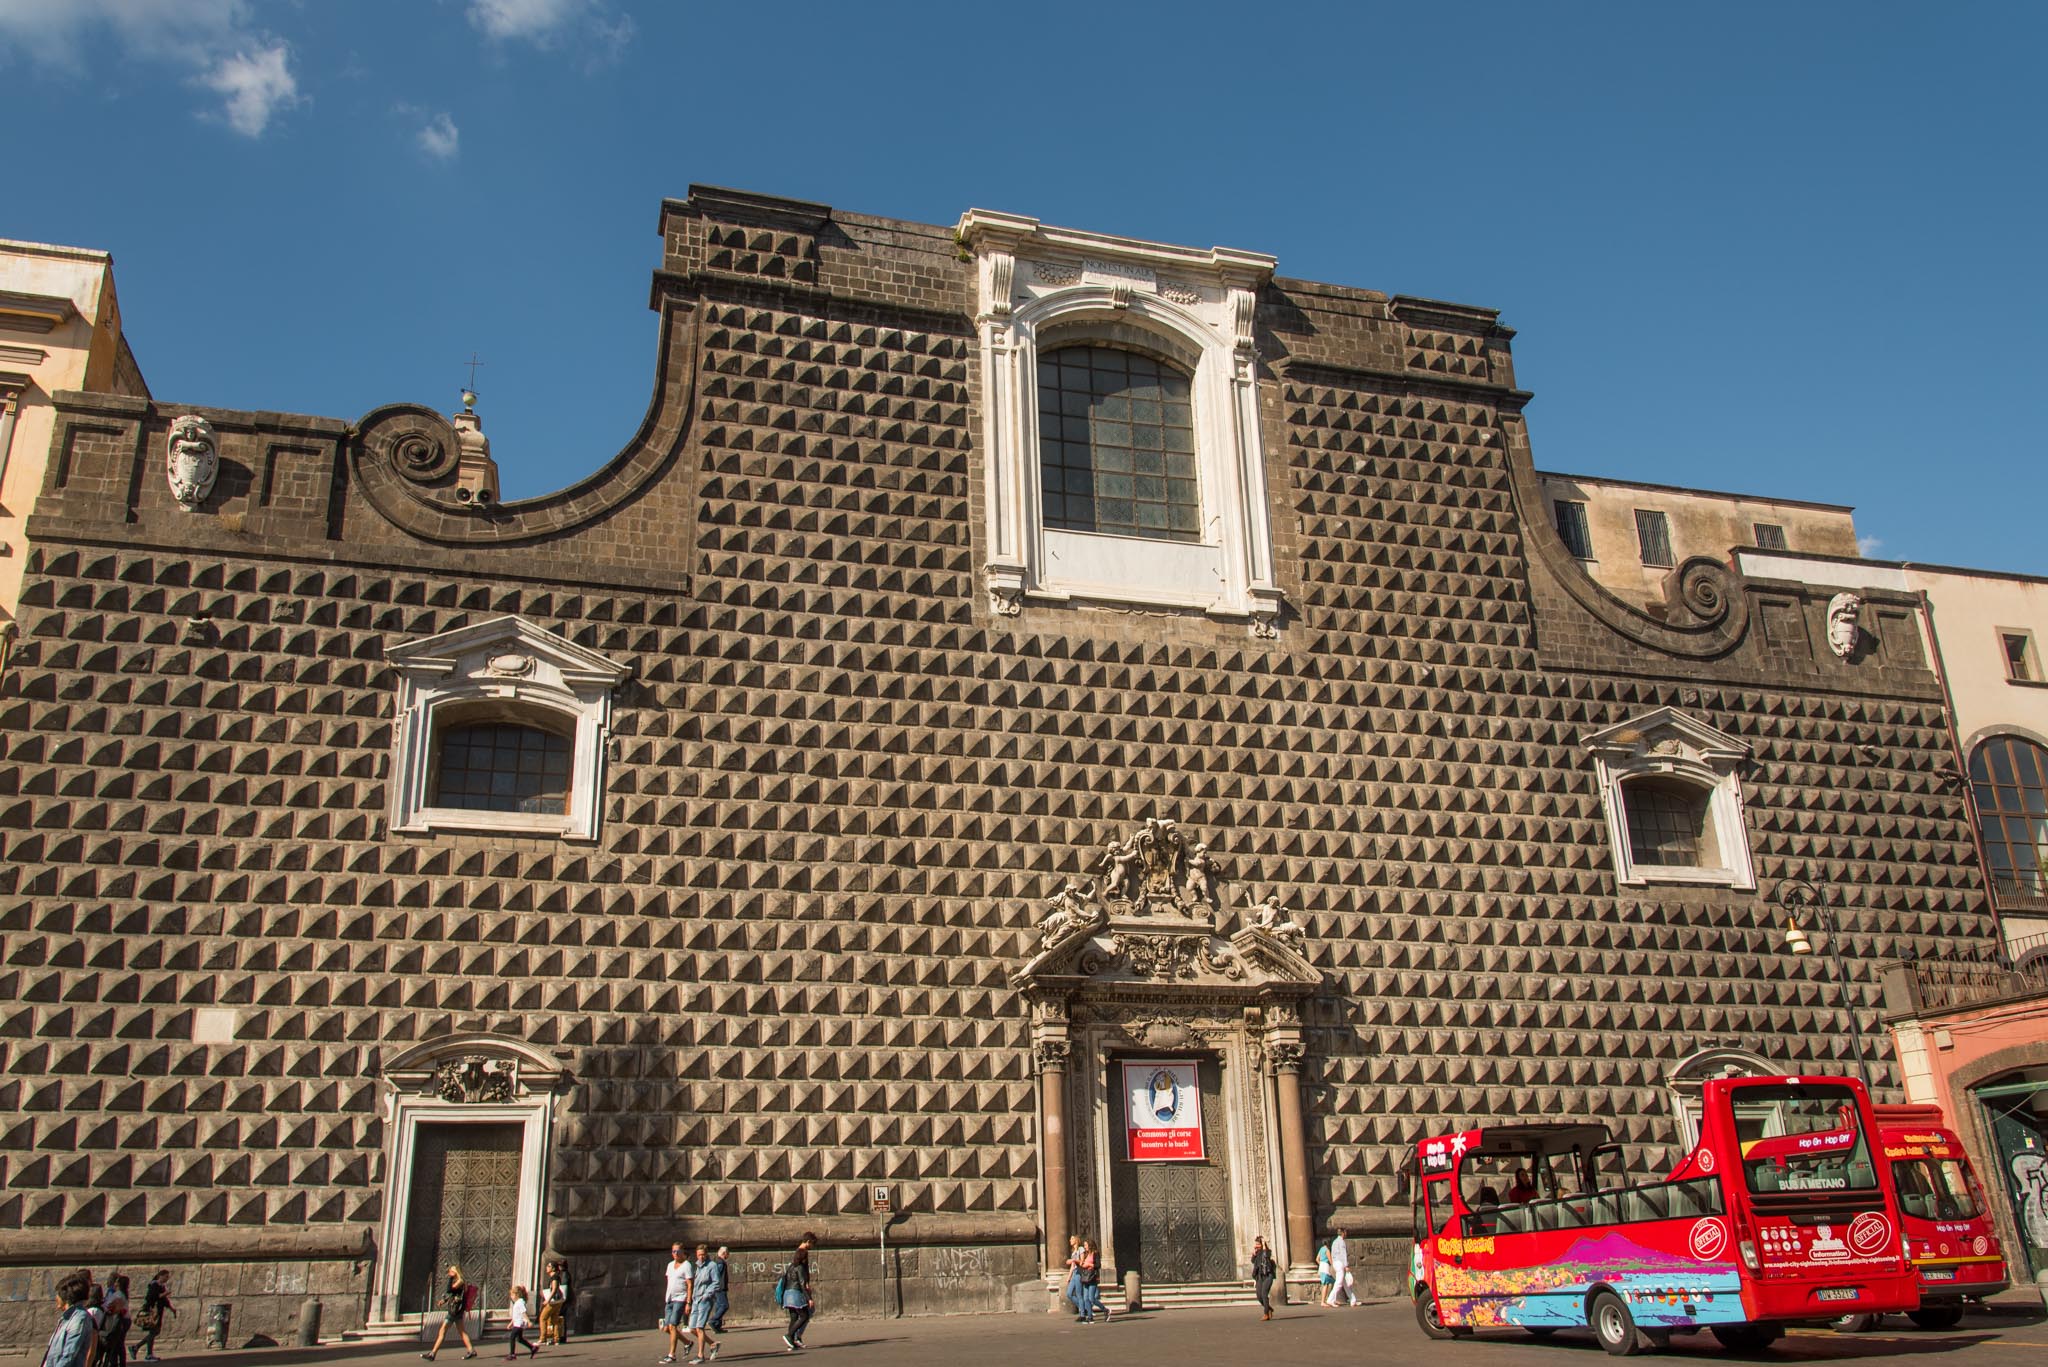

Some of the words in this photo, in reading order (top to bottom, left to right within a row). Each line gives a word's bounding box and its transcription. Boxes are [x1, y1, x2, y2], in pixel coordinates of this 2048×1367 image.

[1108, 263, 1121, 272] EST
[1125, 264, 1134, 273] IN
[1137, 1129, 1168, 1137] Commosso
[1799, 1139, 1811, 1148] Hop
[1813, 1137, 1822, 1146] On
[1825, 1136, 1838, 1145] Hop
[1839, 1134, 1850, 1143] Off
[1808, 1178, 1846, 1190] METANO
[1696, 1228, 1719, 1249] OFFICIAL
[1855, 1222, 1884, 1244] OFFICIAL
[1813, 1250, 1847, 1258] Information
